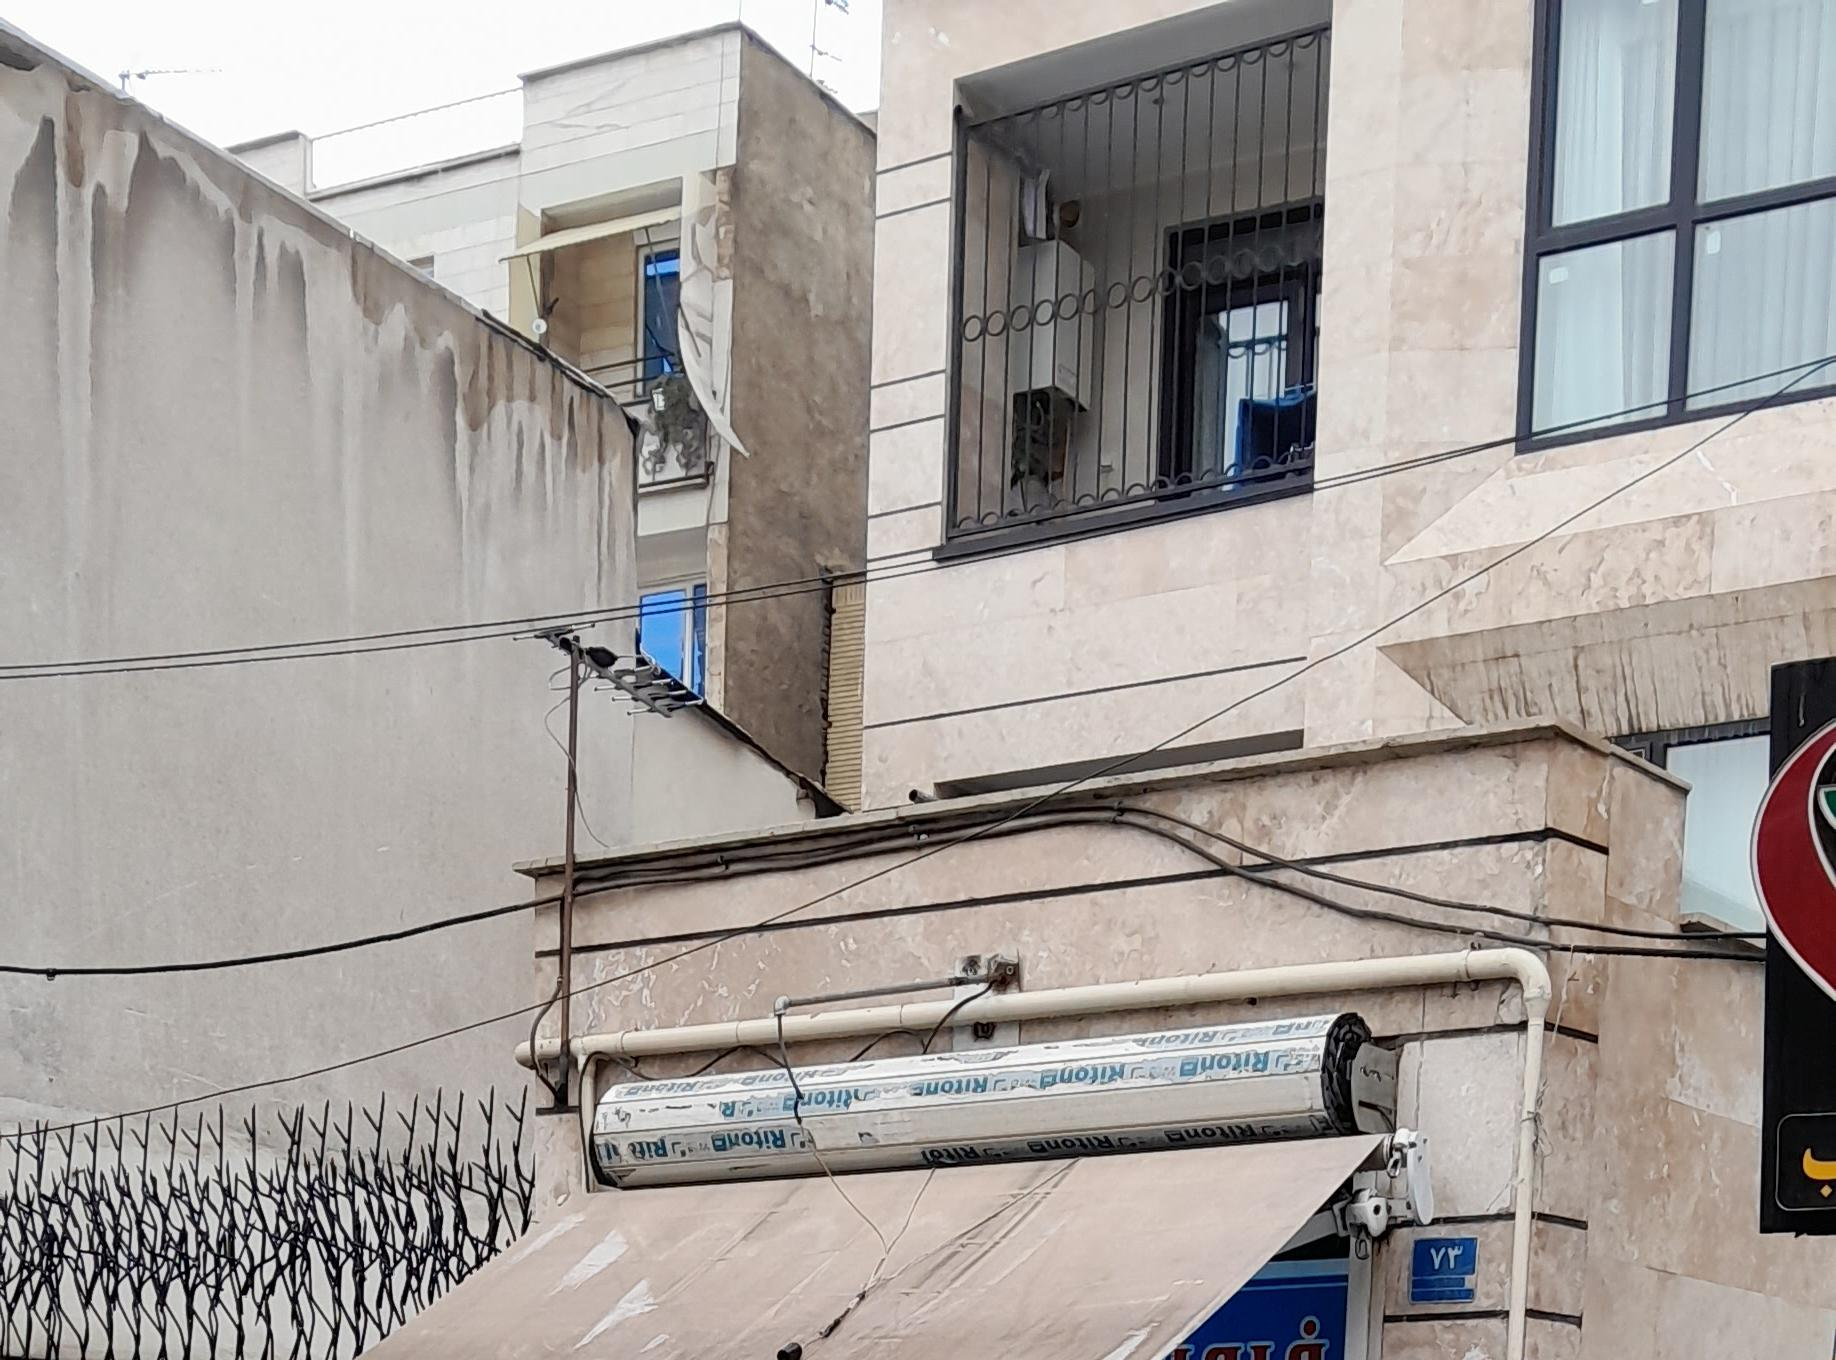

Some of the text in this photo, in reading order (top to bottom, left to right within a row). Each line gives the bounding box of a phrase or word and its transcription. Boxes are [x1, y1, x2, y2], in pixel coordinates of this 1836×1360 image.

[1201, 1051, 1270, 1072] Riton
[726, 1129, 785, 1152] Riton
[1430, 1246, 1463, 1270] ۷۳
